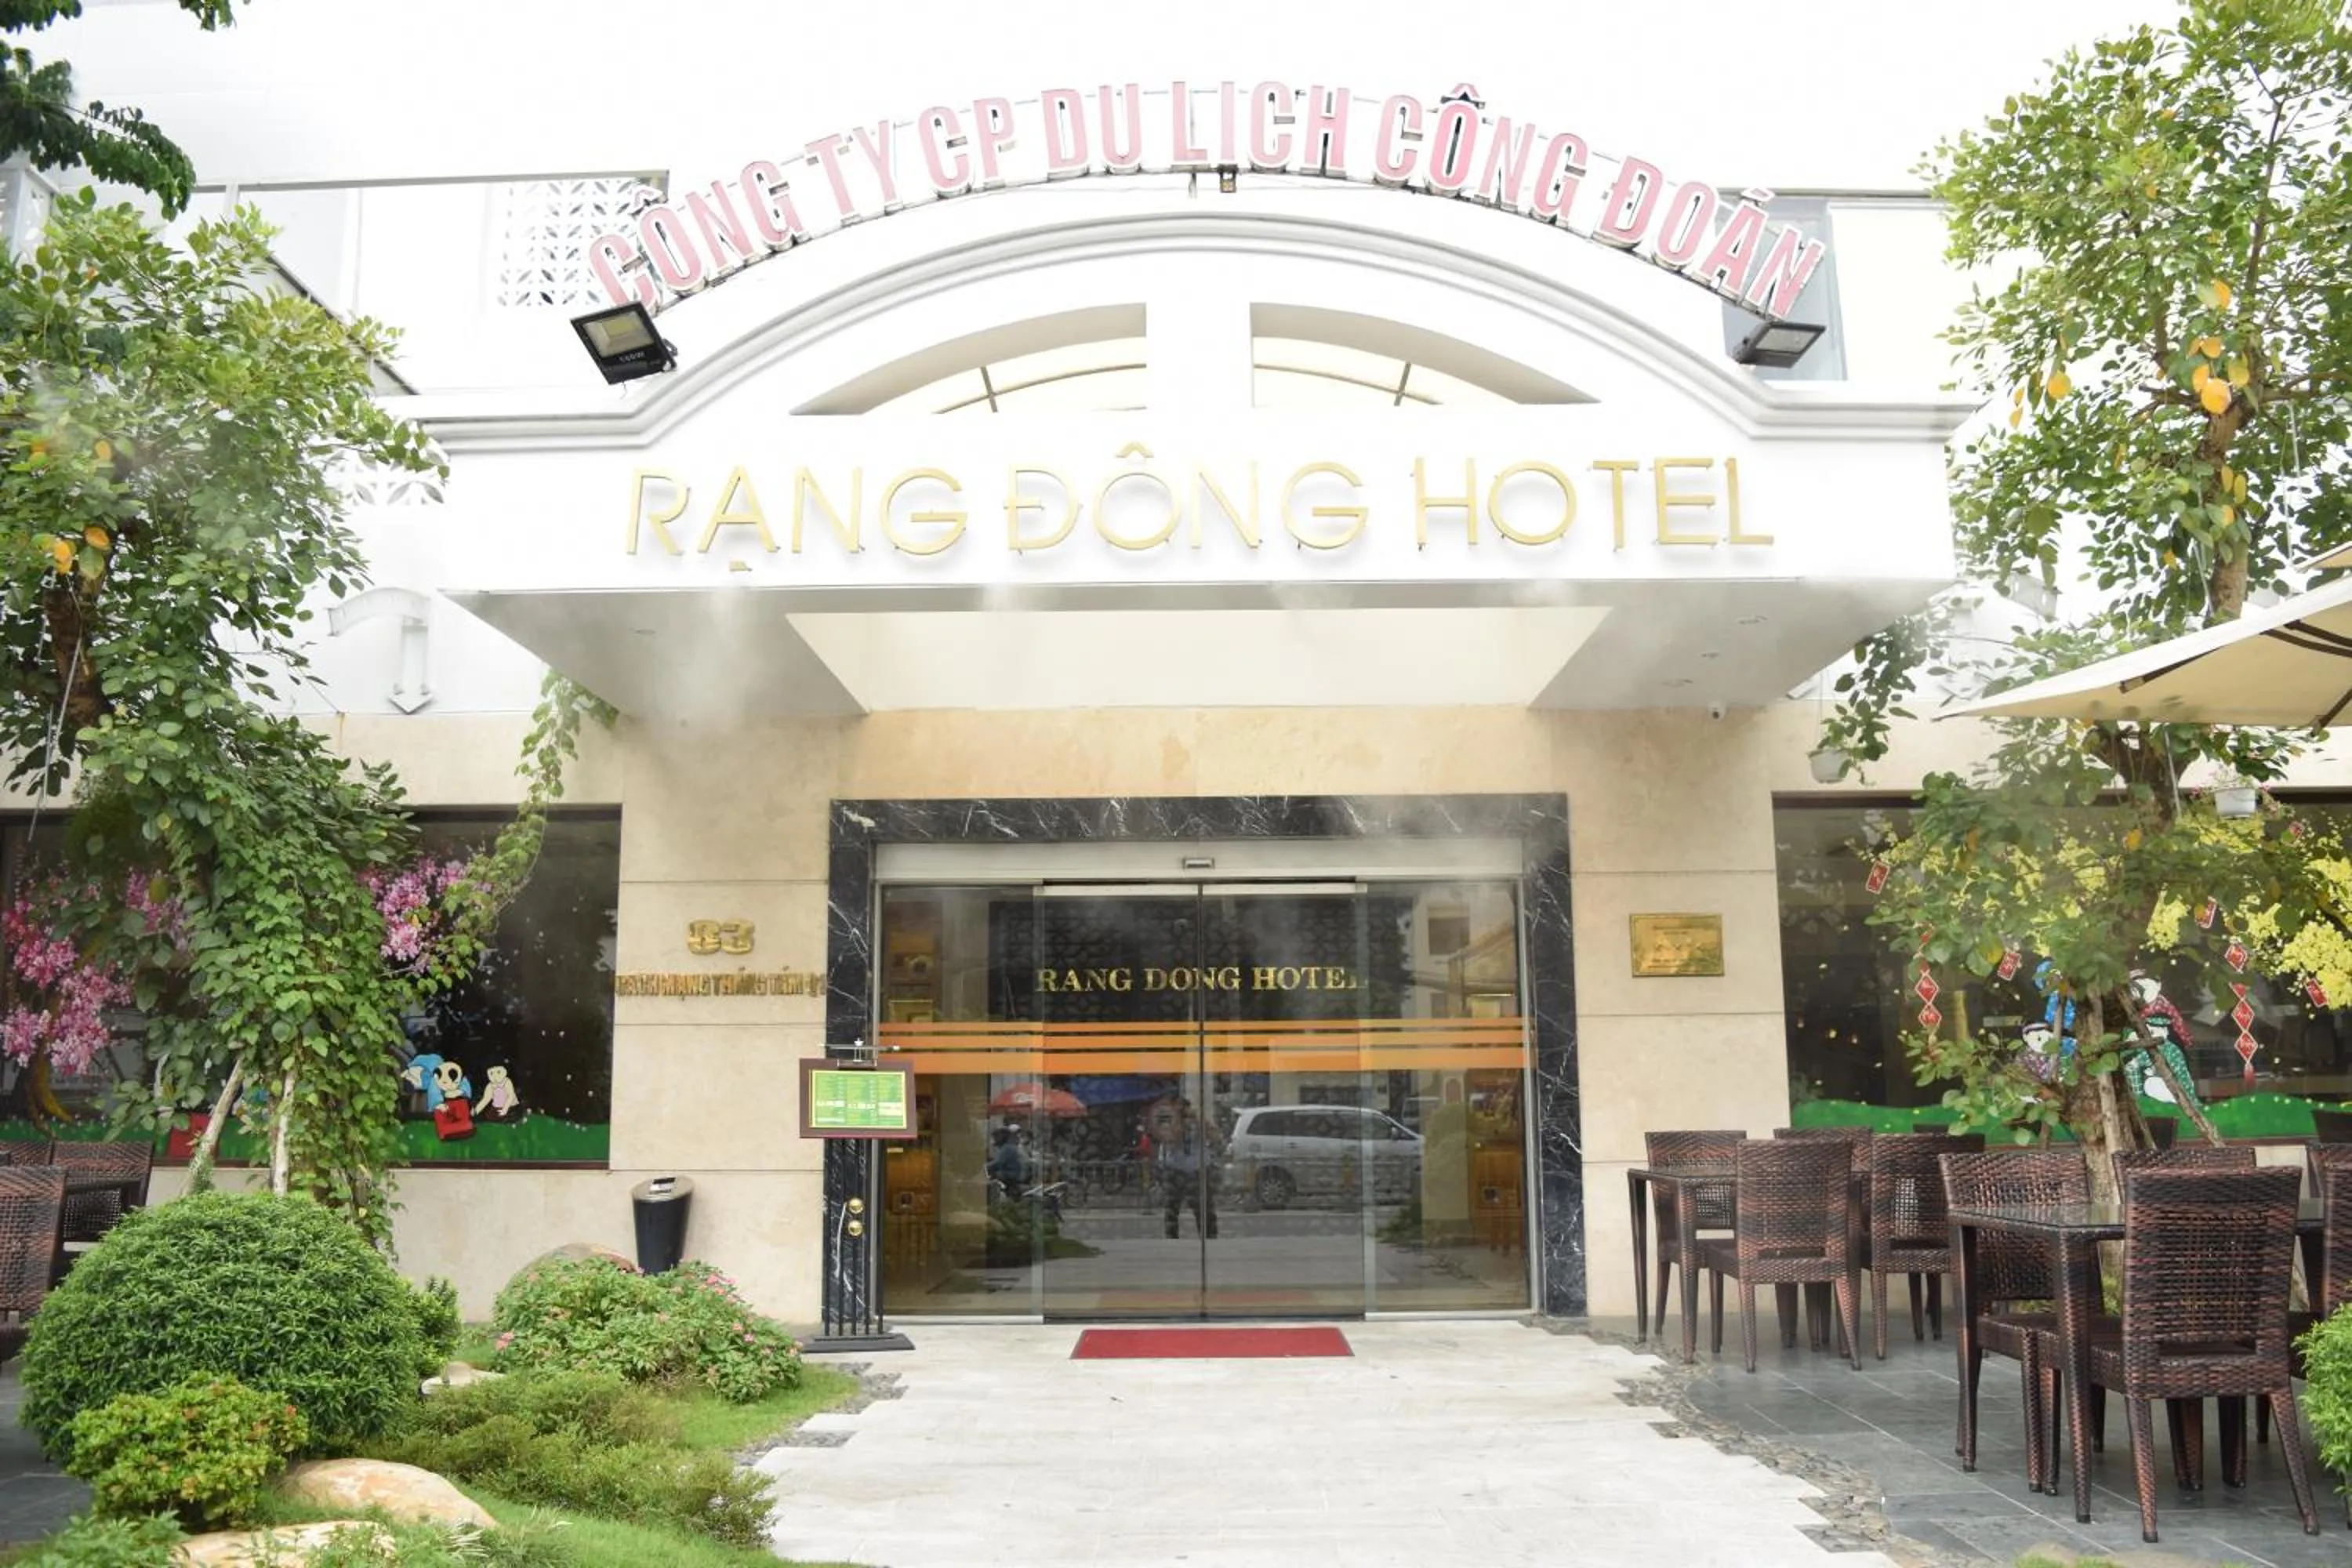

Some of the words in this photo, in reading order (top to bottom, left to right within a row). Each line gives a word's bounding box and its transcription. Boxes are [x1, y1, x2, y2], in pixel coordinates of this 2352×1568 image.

[589, 189, 804, 312] CÔNG
[804, 120, 897, 216] TY
[917, 96, 1014, 191] CP
[1040, 83, 1142, 169] DU
[1376, 82, 1588, 218] CÔNG
[1598, 155, 1824, 319] ĐOÀN
[626, 466, 968, 571] RẠNG
[1005, 441, 1369, 550] ĐÔNG
[1414, 457, 1774, 549] HOTEL
[1036, 967, 1133, 993] RANG
[1143, 966, 1241, 992] DONG
